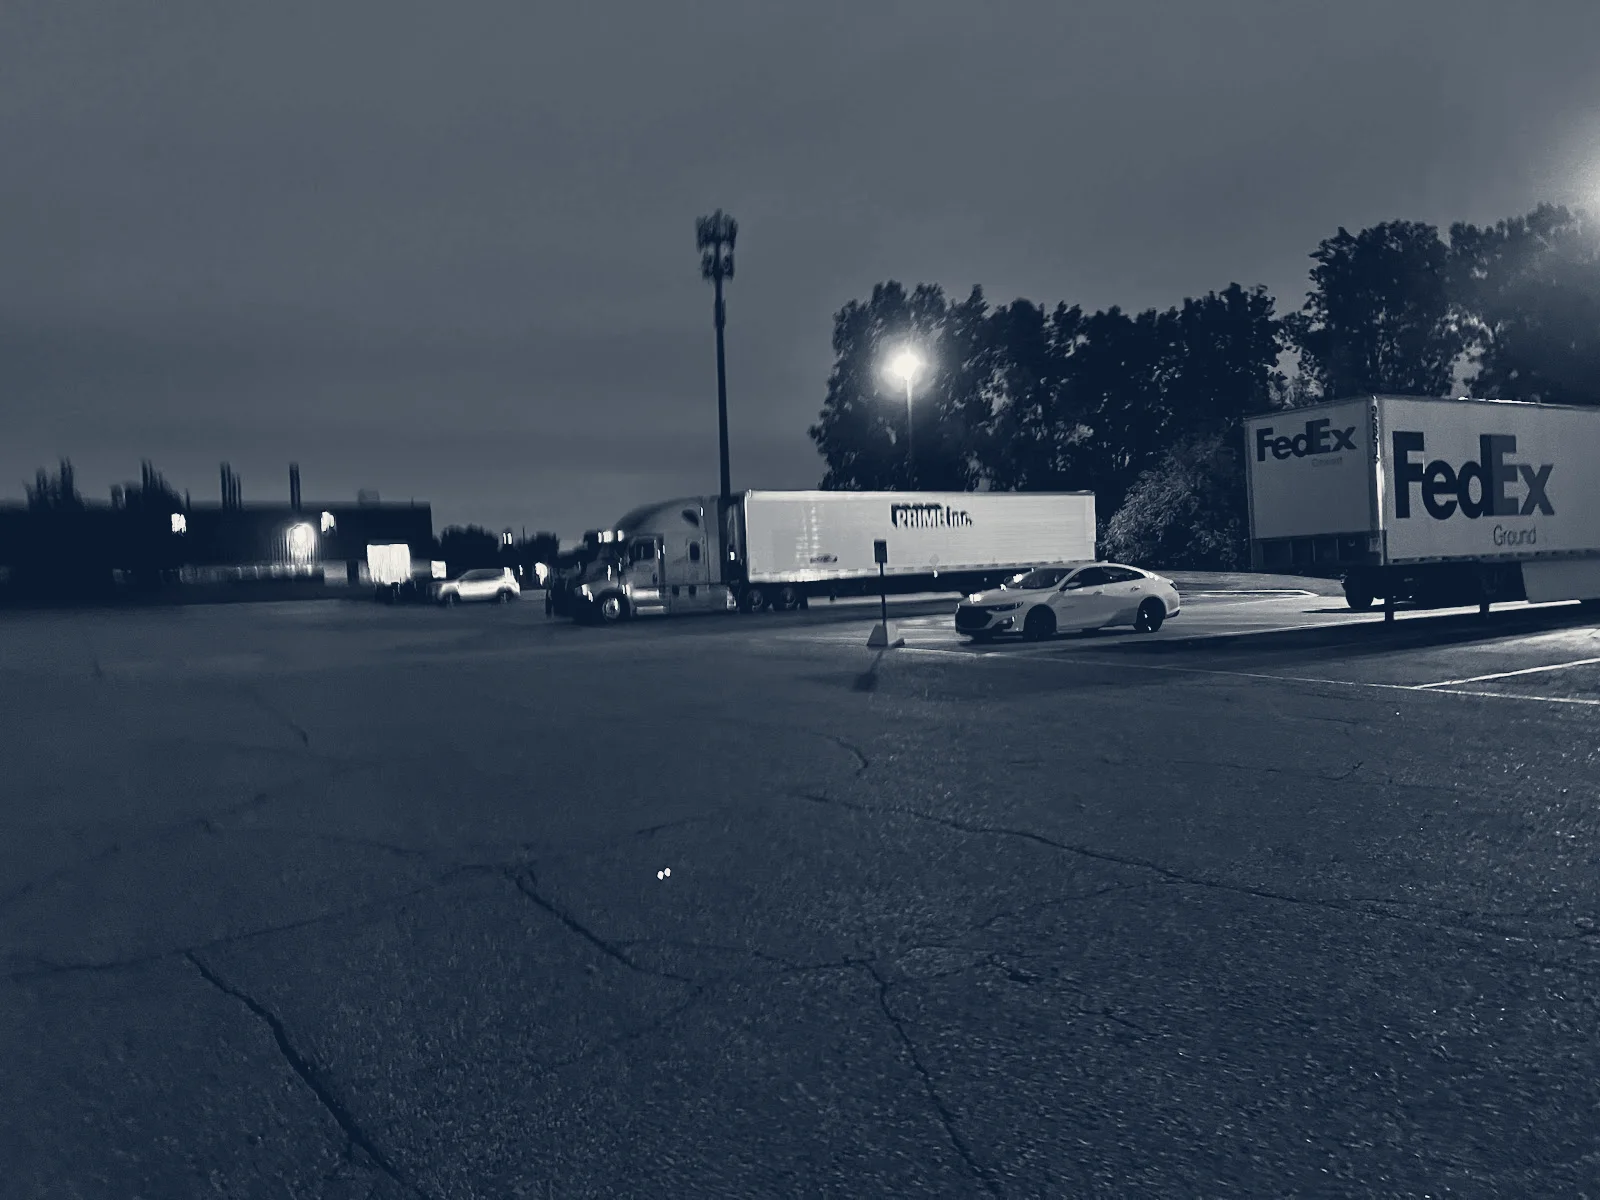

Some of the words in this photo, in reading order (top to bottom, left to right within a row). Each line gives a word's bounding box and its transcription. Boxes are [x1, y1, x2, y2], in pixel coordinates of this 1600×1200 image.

[1257, 418, 1357, 462] FedEx
[1392, 430, 1555, 520] FedEx
[891, 503, 943, 529] PRIME
[1493, 524, 1537, 546] Ground
